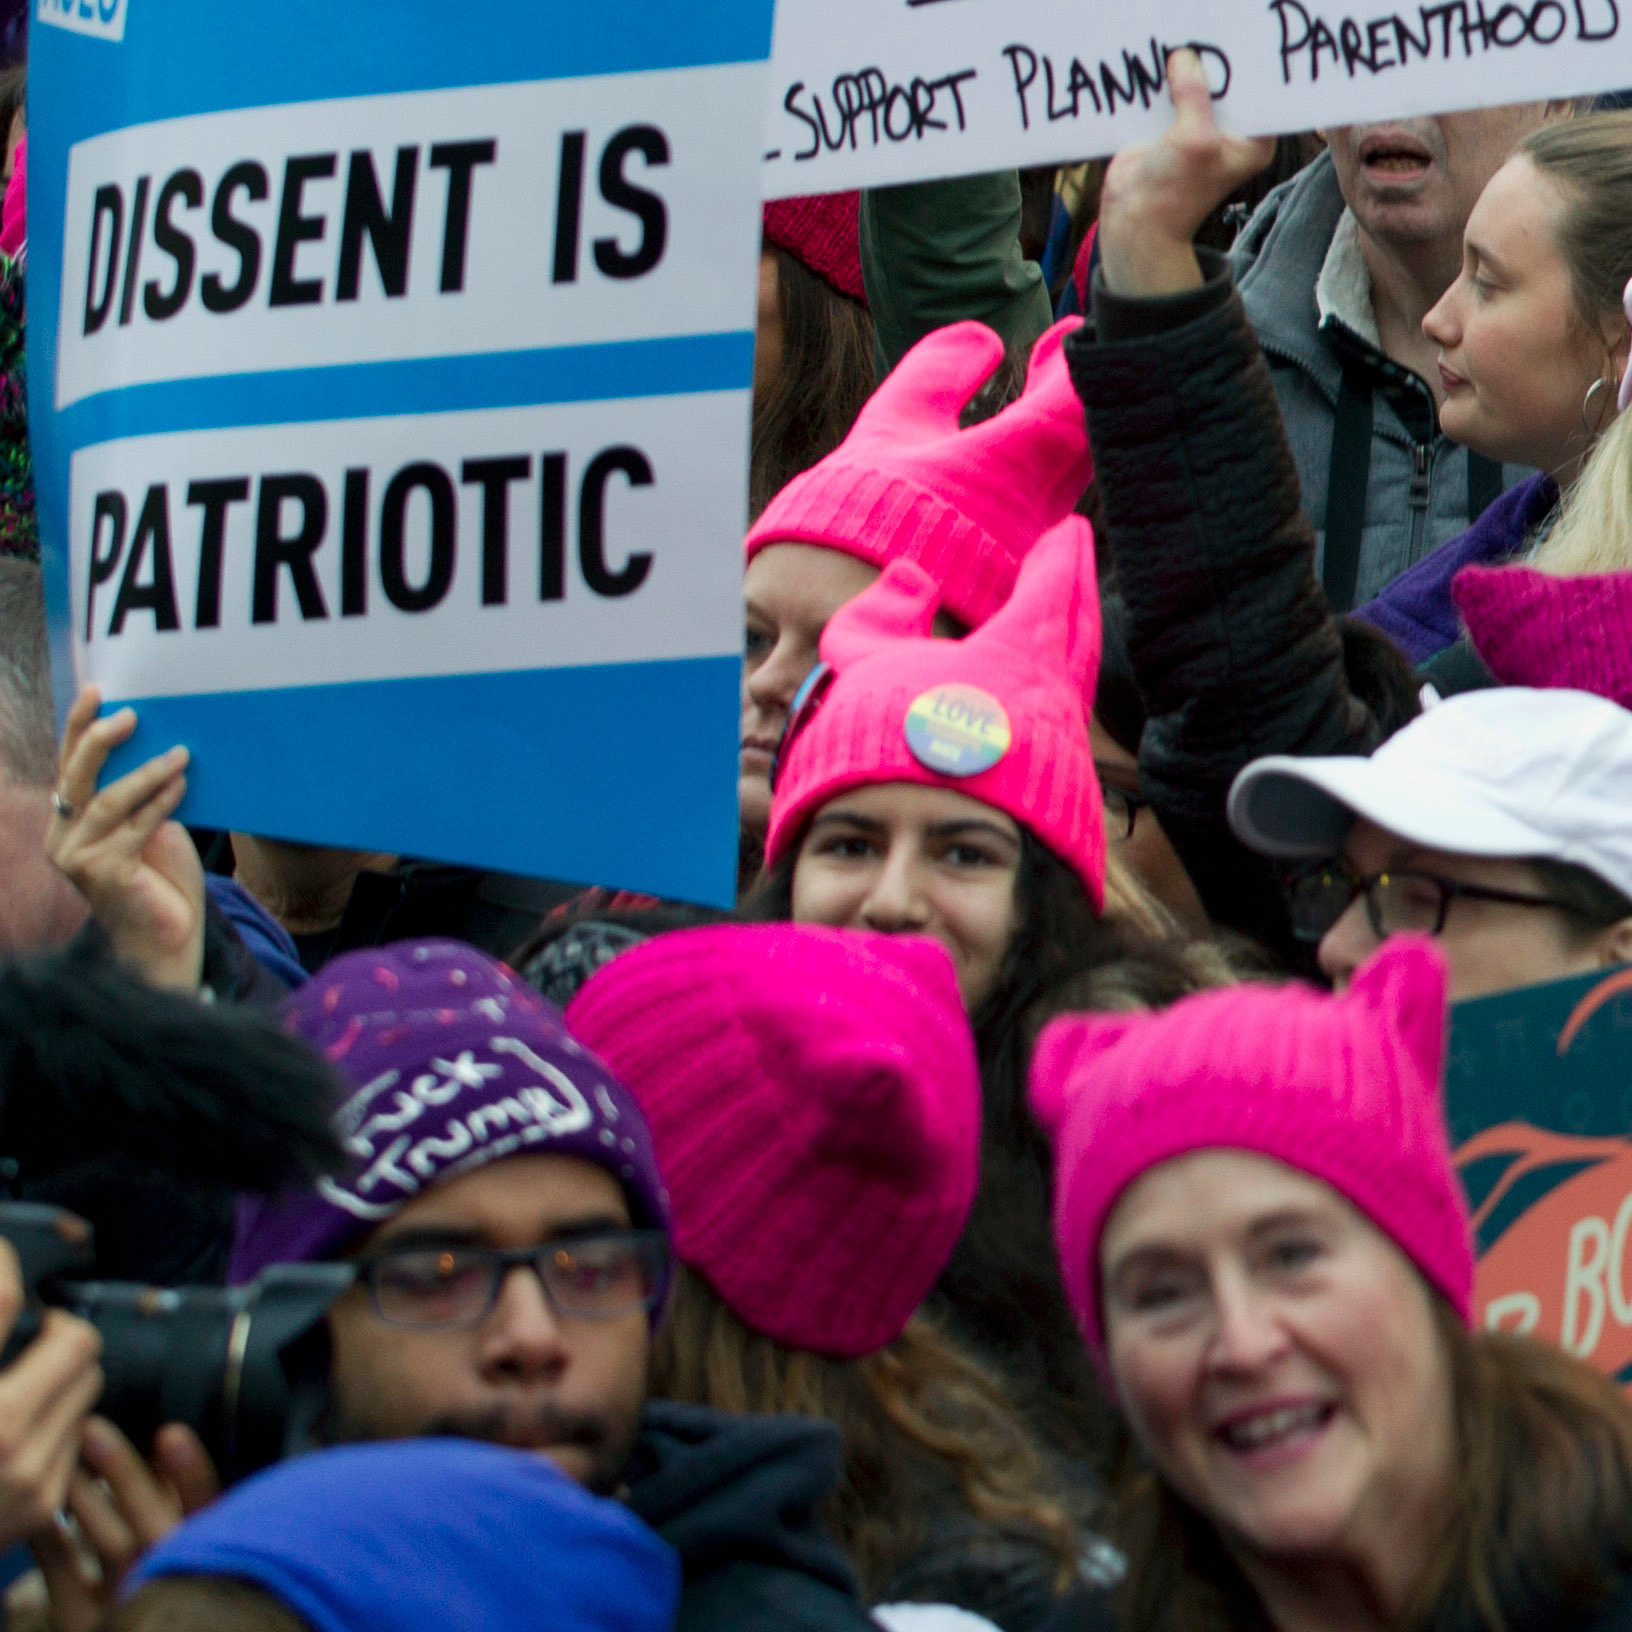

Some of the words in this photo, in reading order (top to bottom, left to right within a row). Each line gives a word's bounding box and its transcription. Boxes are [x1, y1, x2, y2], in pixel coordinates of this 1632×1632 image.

[1003, 38, 1233, 132] PLANND
[82, 136, 498, 338] DISSENT
[550, 123, 670, 285] IS
[85, 442, 656, 644] PATRIOTIC
